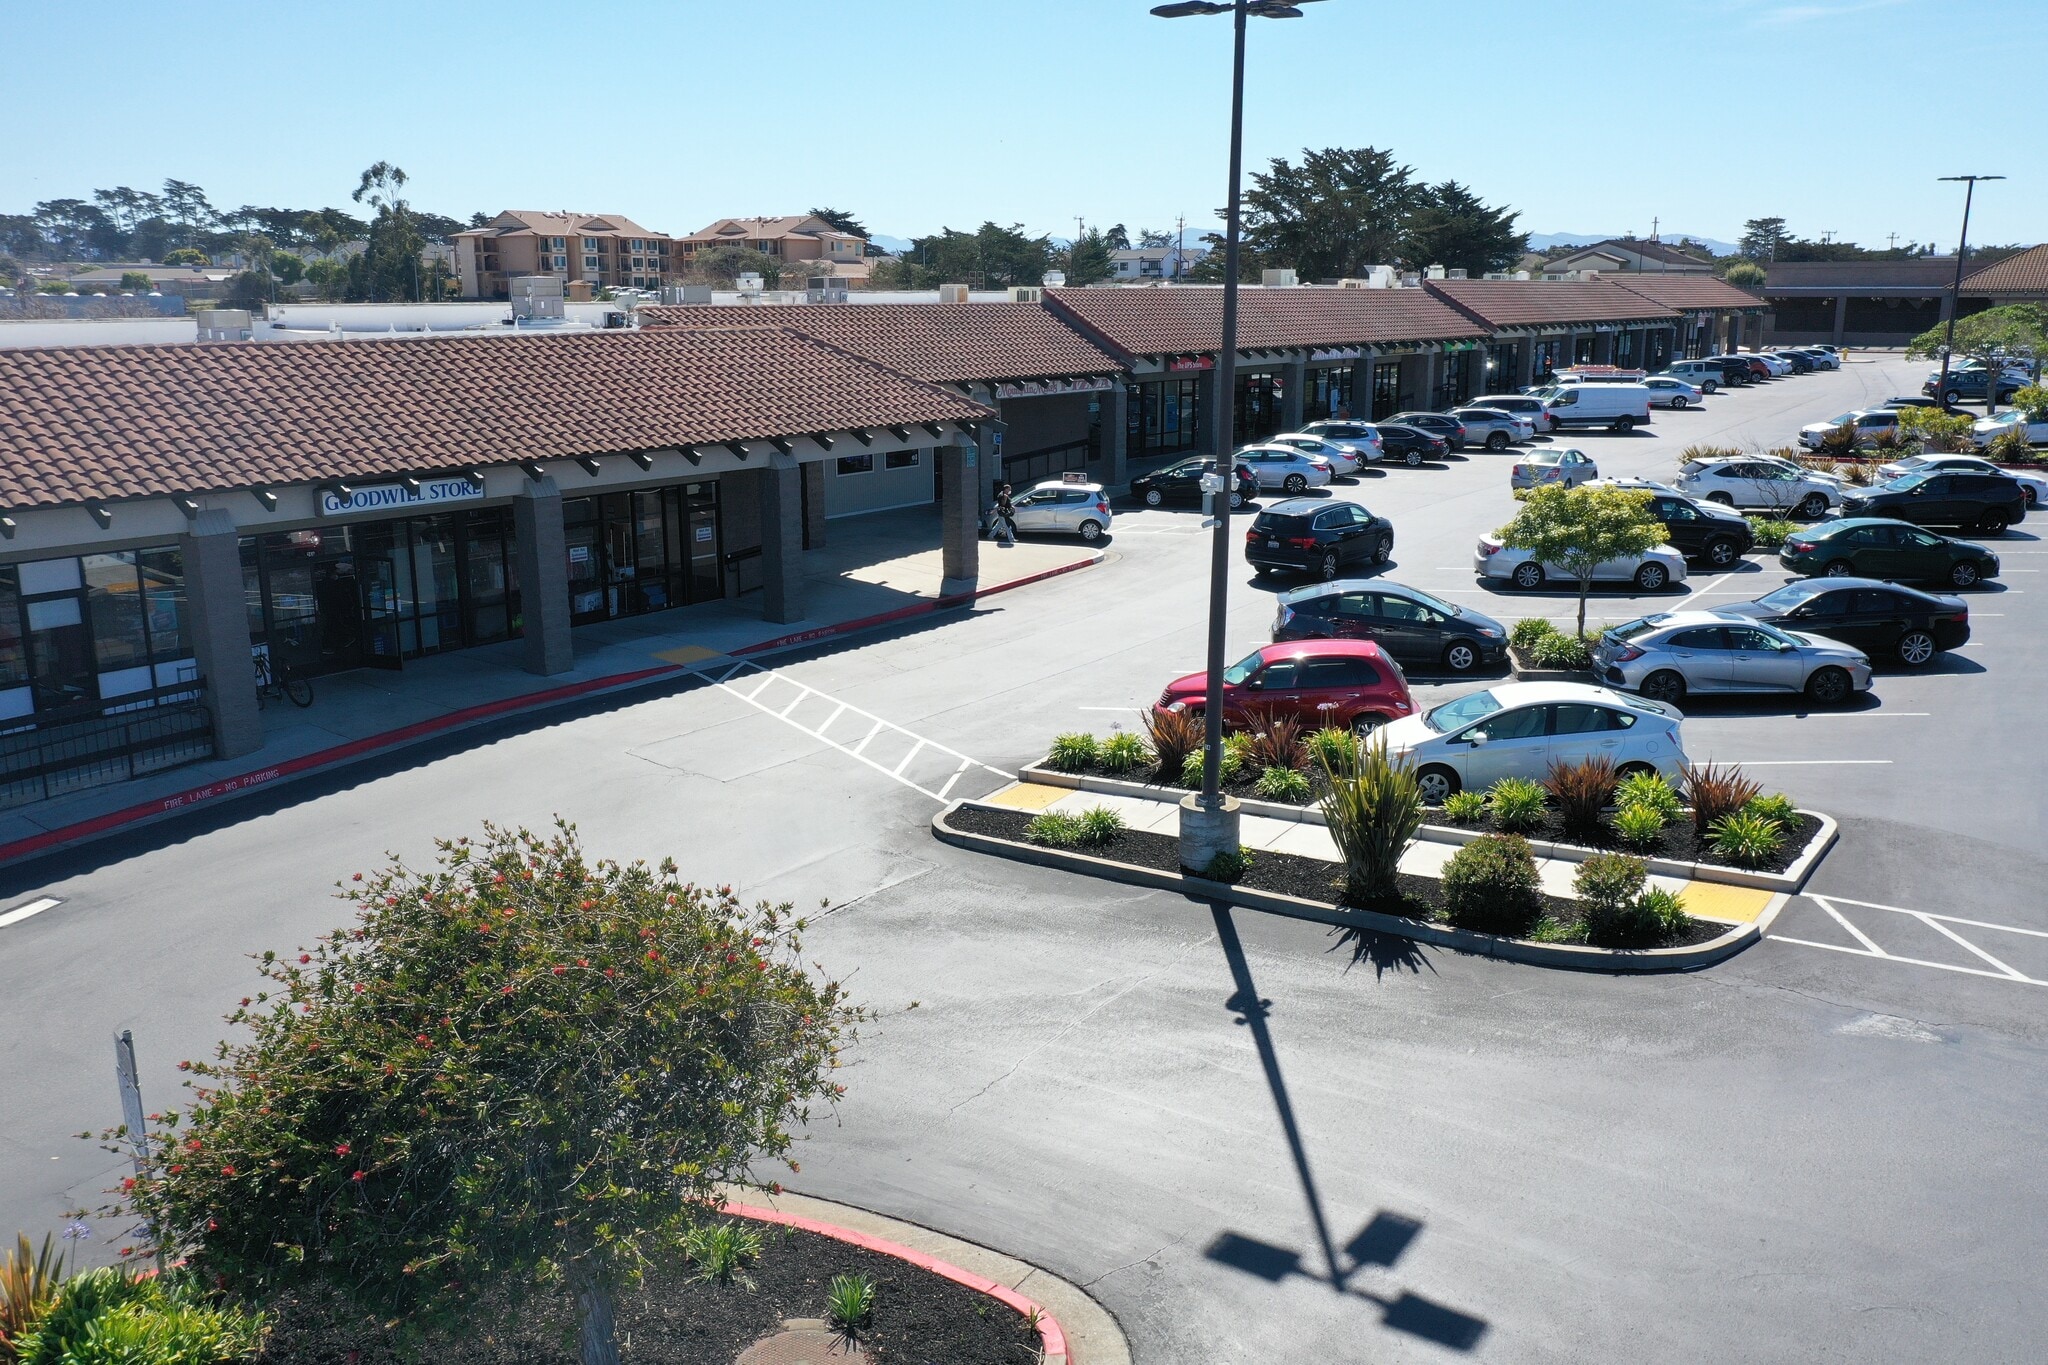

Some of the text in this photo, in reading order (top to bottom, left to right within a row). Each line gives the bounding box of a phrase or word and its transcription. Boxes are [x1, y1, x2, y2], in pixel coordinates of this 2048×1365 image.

[1184, 361, 1193, 369] UPS
[164, 797, 184, 810] FIRE
[189, 788, 214, 802] LANE
[224, 781, 238, 792] NO
[243, 769, 280, 787] PARKING
